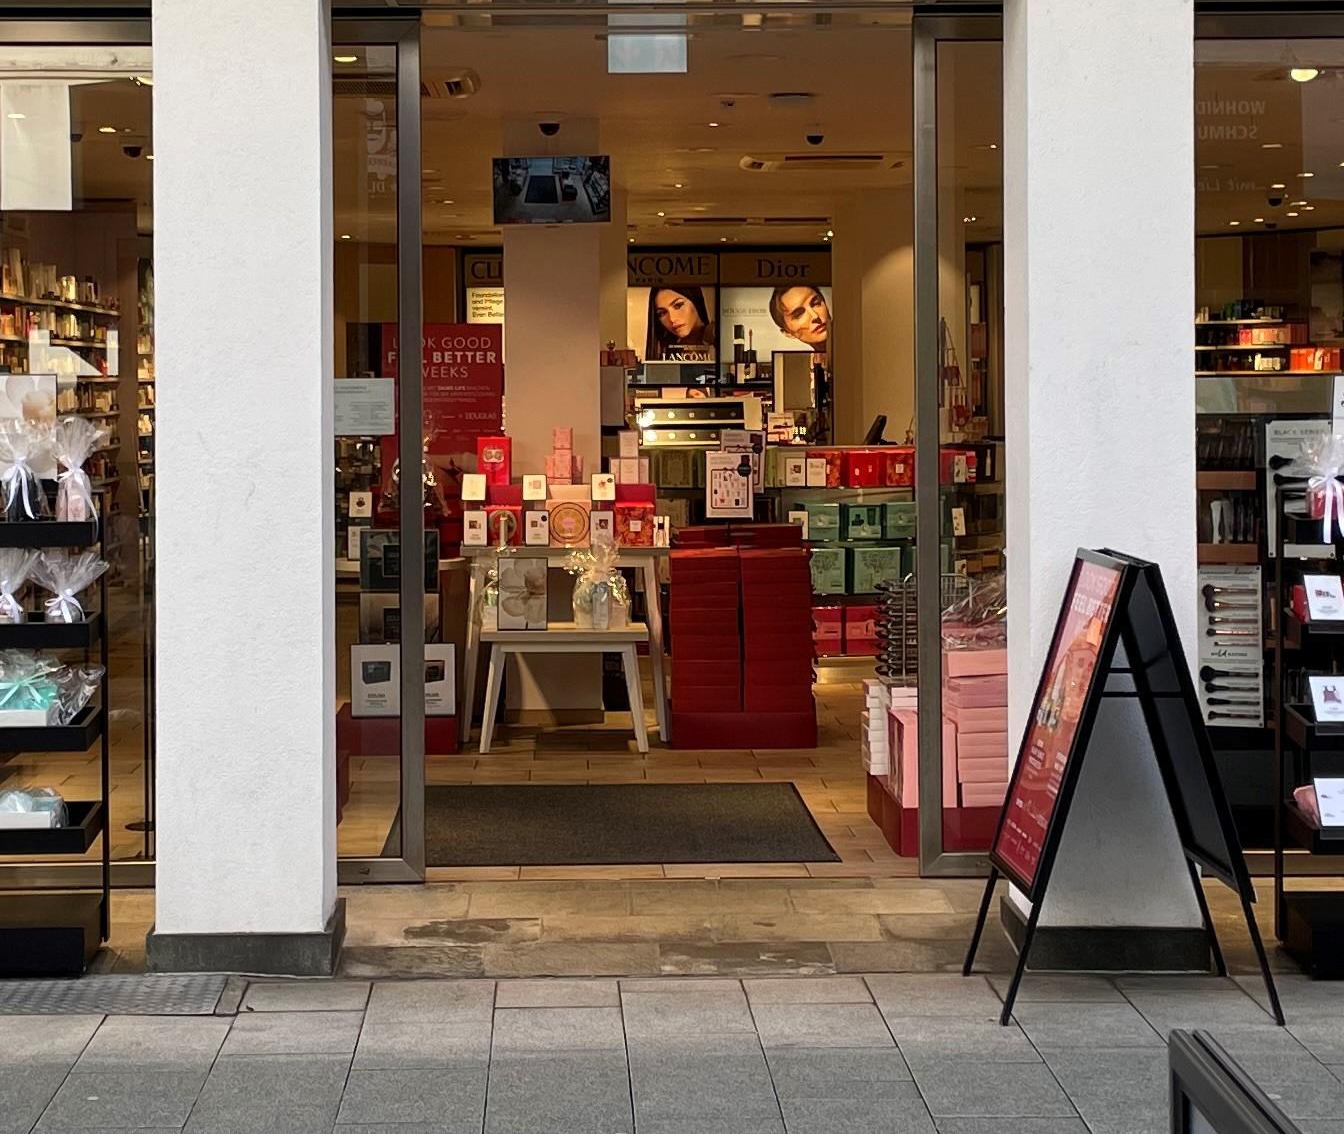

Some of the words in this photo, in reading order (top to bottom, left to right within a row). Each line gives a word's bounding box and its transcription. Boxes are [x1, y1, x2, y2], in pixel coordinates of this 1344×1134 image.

[627, 255, 712, 276] NCOME
[757, 258, 811, 278] Dior
[441, 337, 492, 350] GOOD
[432, 351, 497, 364] BETTER
